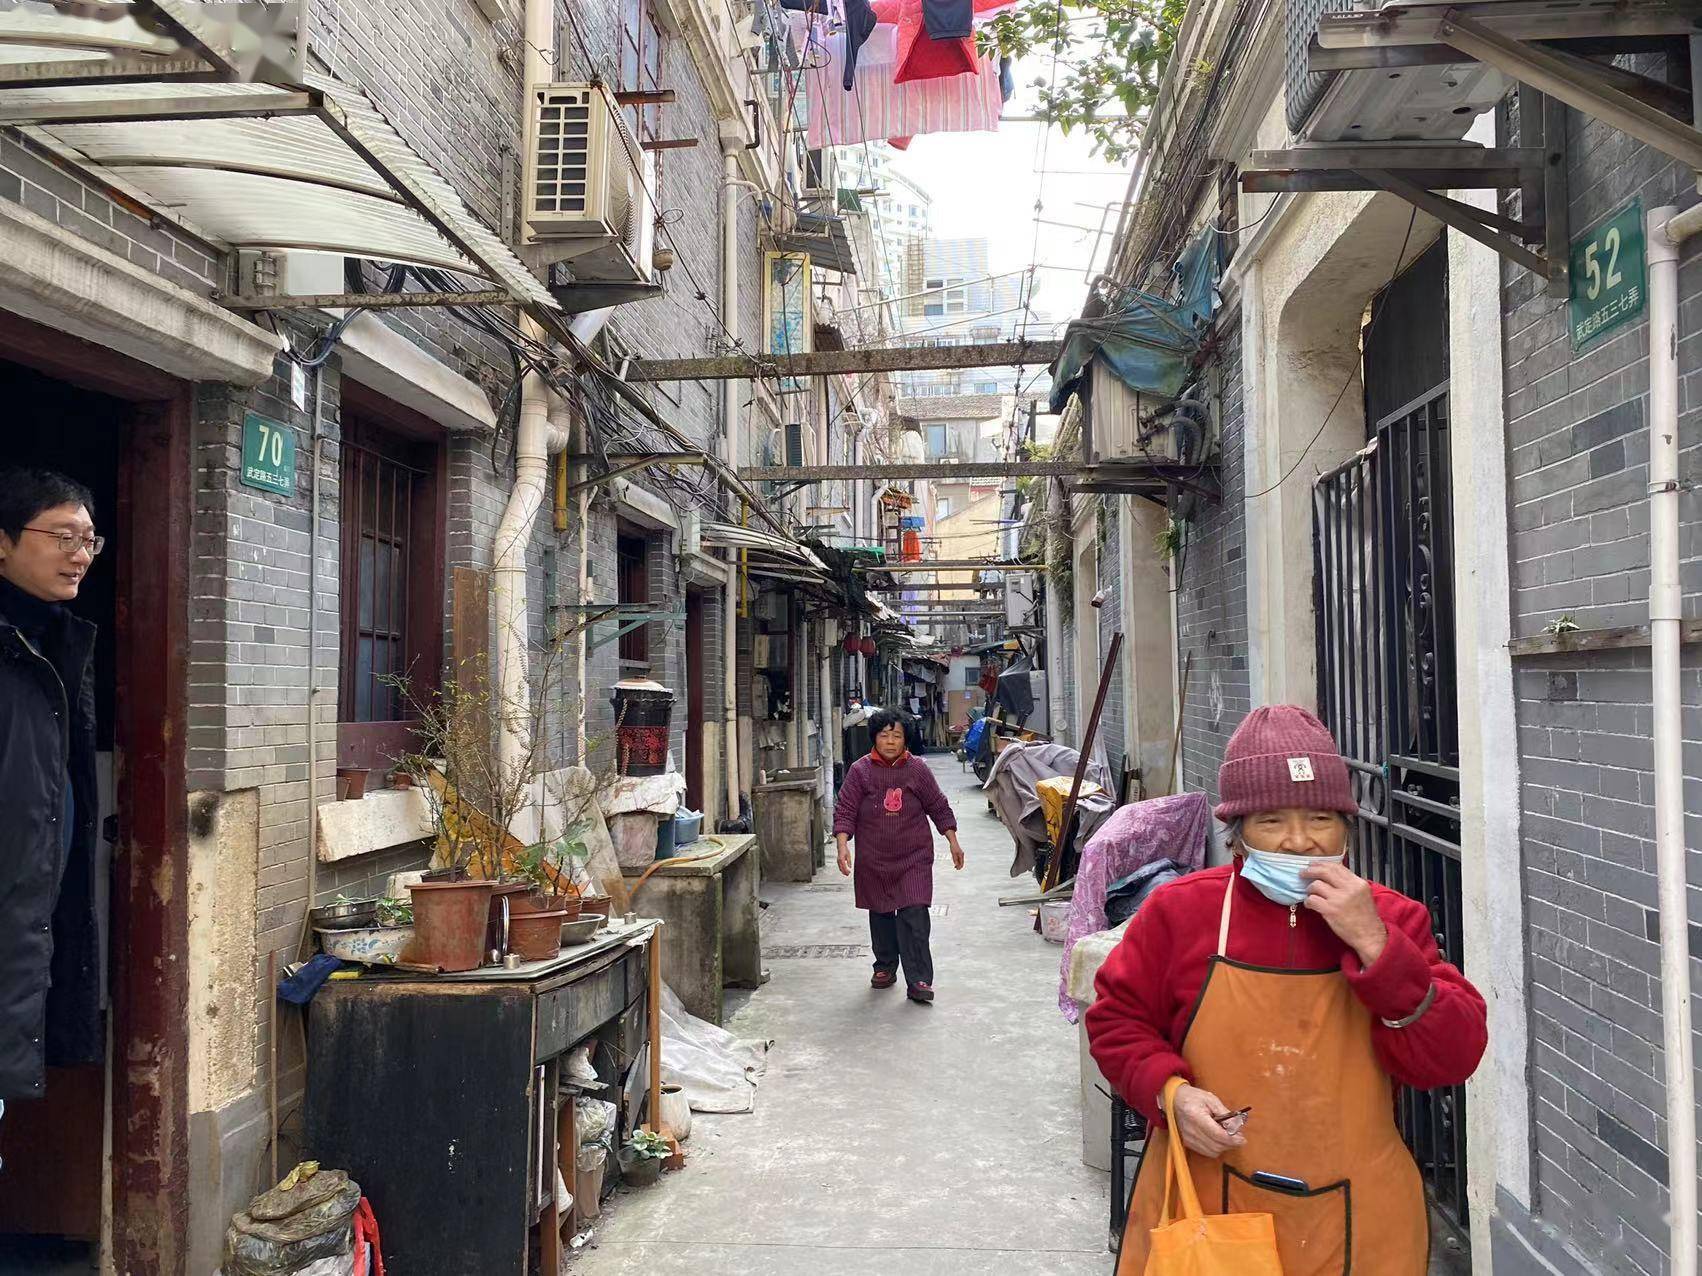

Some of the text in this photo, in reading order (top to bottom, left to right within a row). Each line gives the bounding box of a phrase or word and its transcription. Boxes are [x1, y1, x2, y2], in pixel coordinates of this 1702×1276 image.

[1585, 227, 1621, 300] 52
[1576, 286, 1638, 339] 武定路五三七弄
[259, 425, 282, 466] 70
